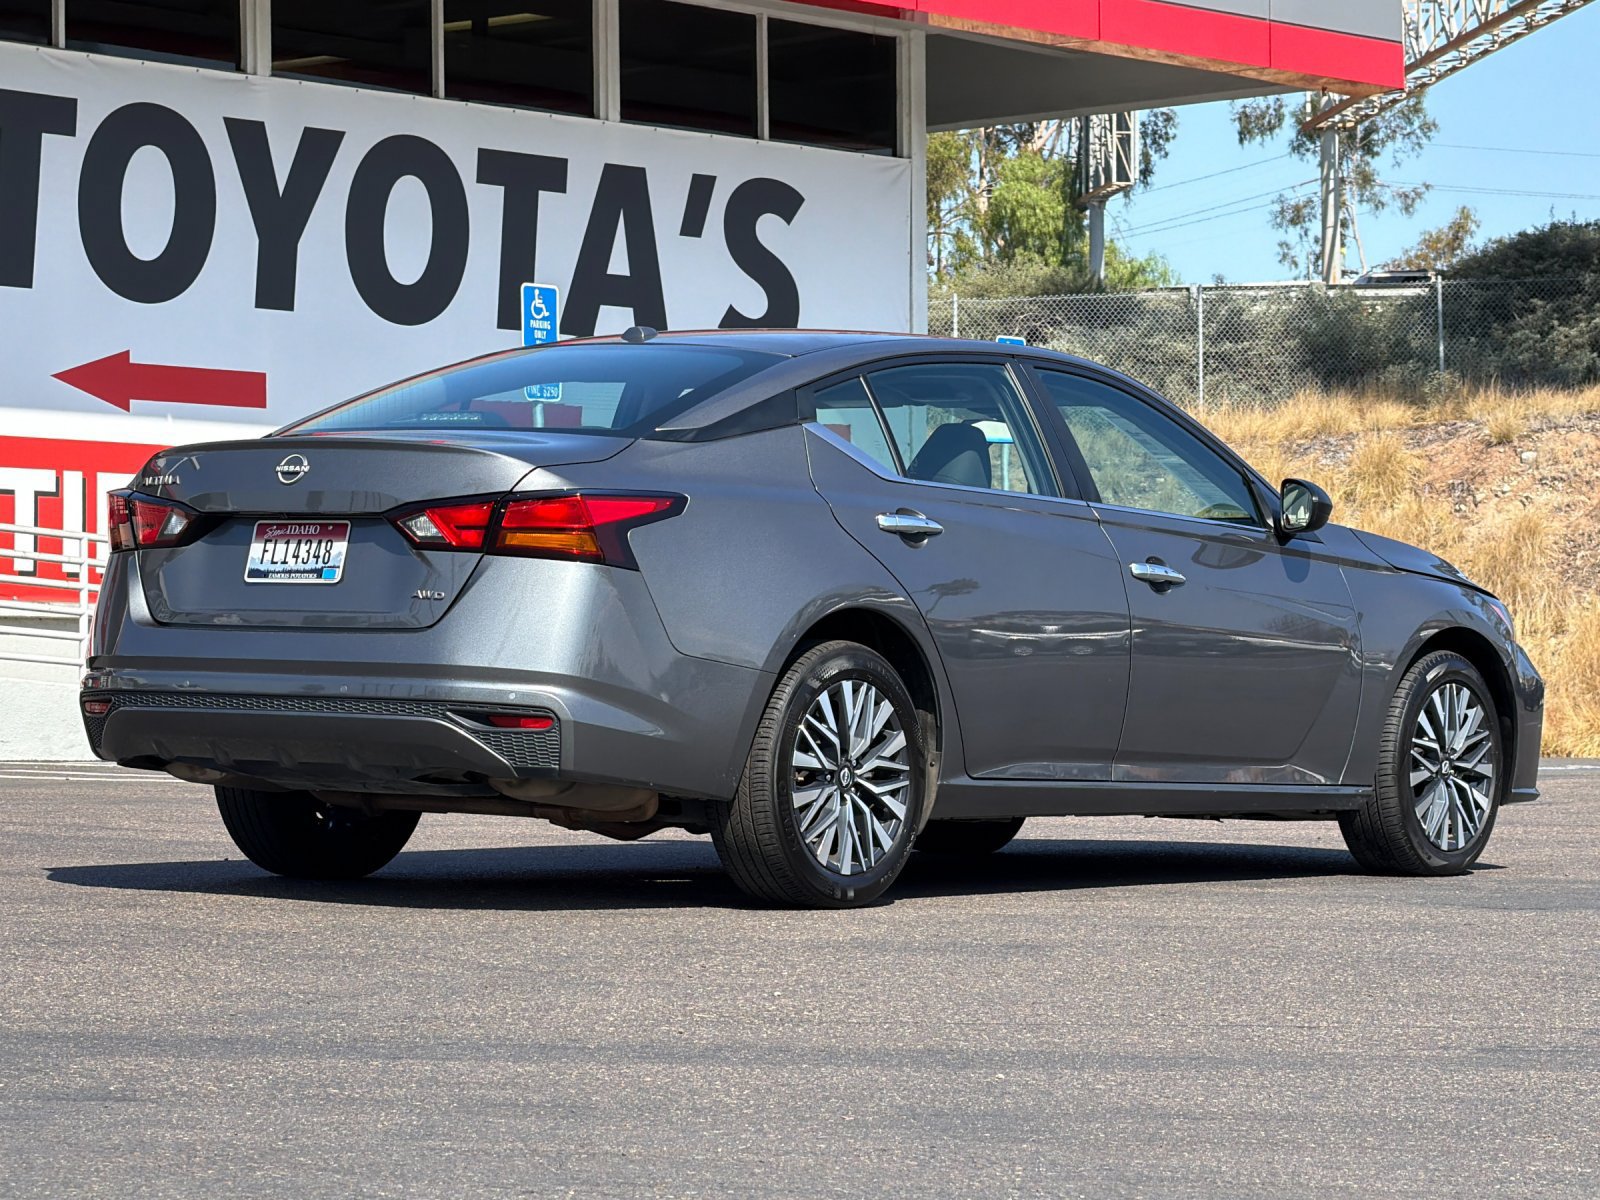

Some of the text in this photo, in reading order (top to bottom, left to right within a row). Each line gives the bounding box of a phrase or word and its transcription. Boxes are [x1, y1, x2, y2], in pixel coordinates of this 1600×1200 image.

[0, 87, 805, 335] TOYOTA'S
[529, 319, 551, 330] PARKING
[534, 329, 547, 339] ONLY
[286, 525, 320, 535] IDAHO
[260, 539, 333, 565] FL14348
[412, 589, 445, 600] AWD
